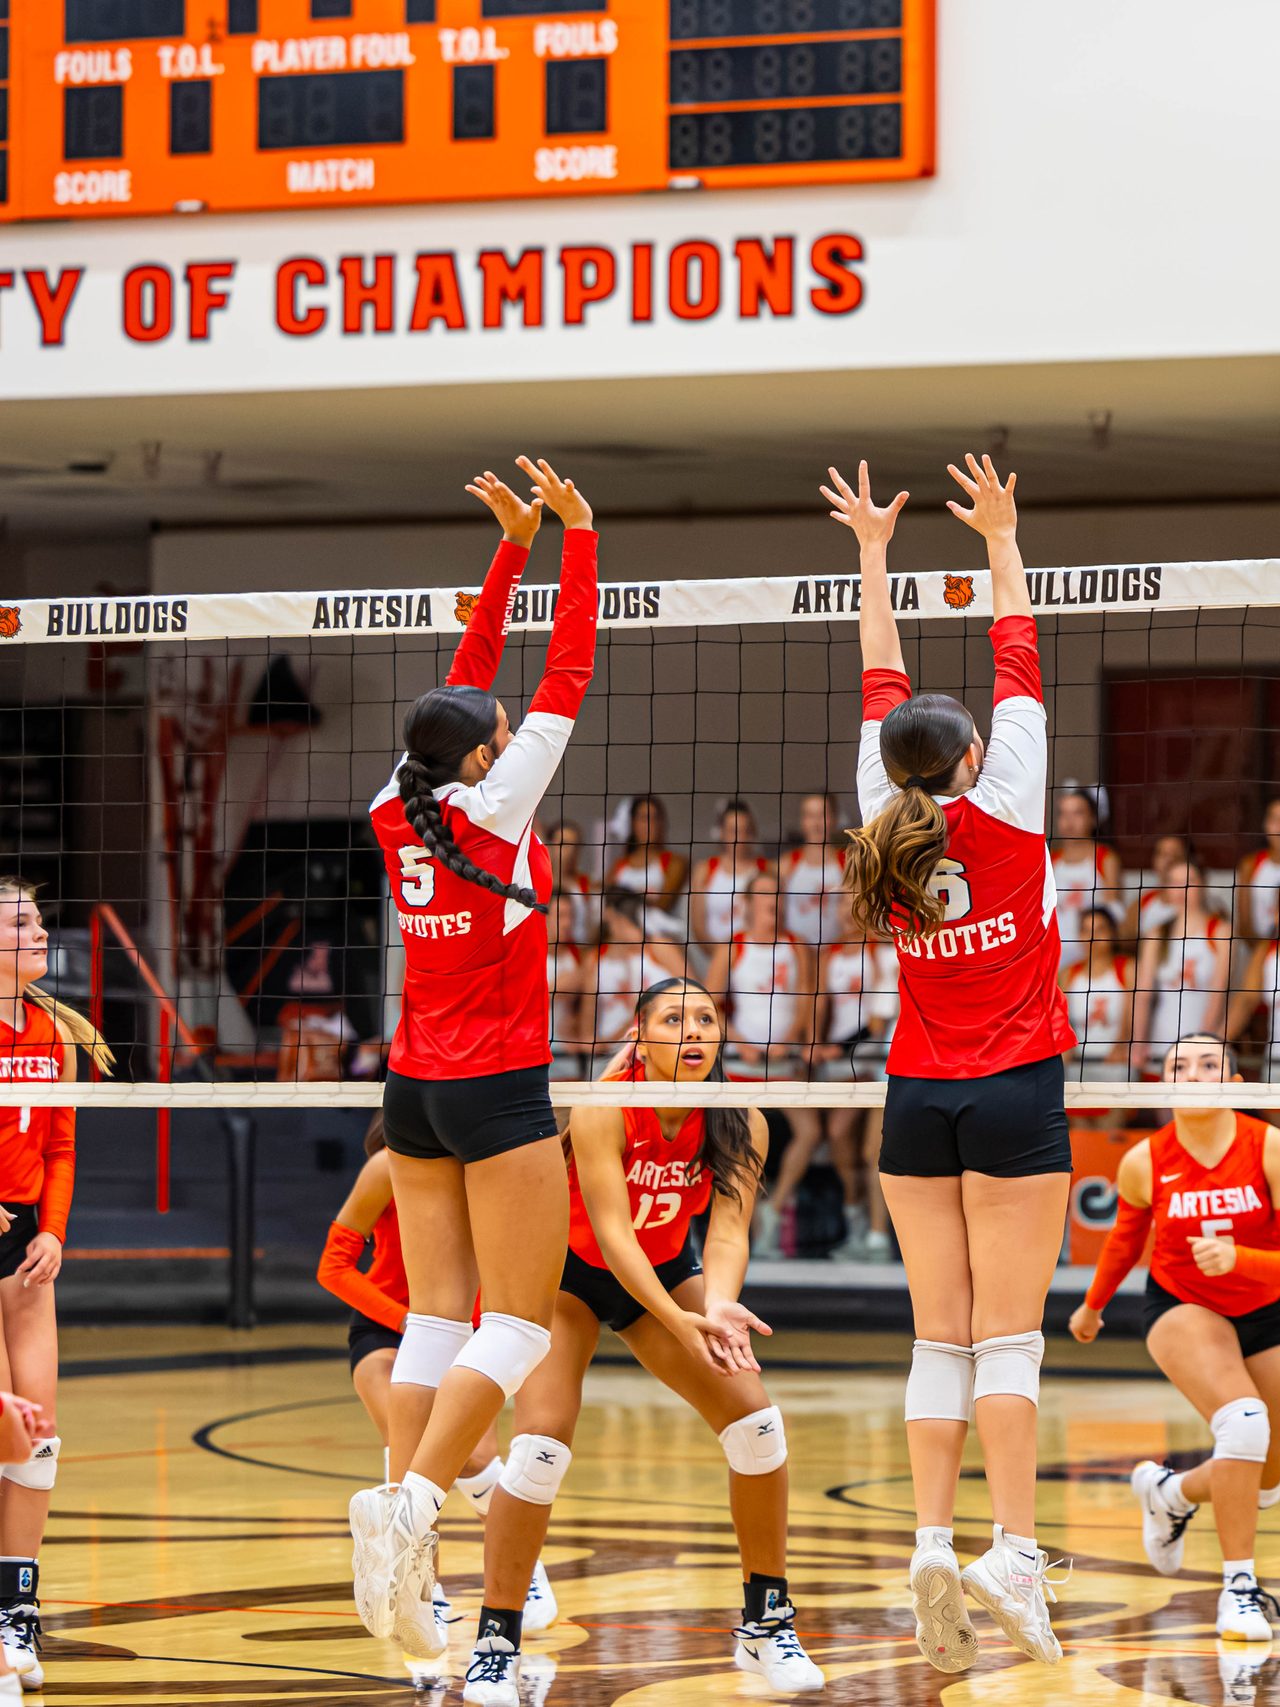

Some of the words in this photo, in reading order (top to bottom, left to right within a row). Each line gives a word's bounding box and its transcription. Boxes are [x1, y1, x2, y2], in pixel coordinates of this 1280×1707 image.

[252, 37, 347, 72] PLAYER
[351, 33, 416, 68] FOUL
[533, 20, 618, 57] FOULS
[54, 48, 133, 84] FOULS
[287, 158, 375, 193] MATCH
[534, 145, 618, 182] SCORE
[54, 169, 132, 205] SCORE
[0, 264, 86, 348] Y
[122, 257, 238, 346] OF
[275, 232, 867, 338] CHAMPIONS
[792, 576, 920, 614] ARTEIA
[1026, 566, 1162, 606] ULLDOGS
[47, 600, 189, 637] BULLDOGS
[312, 594, 433, 630] ARTESIA
[511, 586, 661, 624] BUOGS
[397, 844, 436, 908] 5
[924, 856, 973, 922] 6
[398, 910, 472, 939] OYOTES
[0, 1056, 59, 1080] RTESIA
[626, 1159, 703, 1191] ARTESIA
[632, 1192, 682, 1231] 13
[1167, 1184, 1263, 1219] ARTESIA
